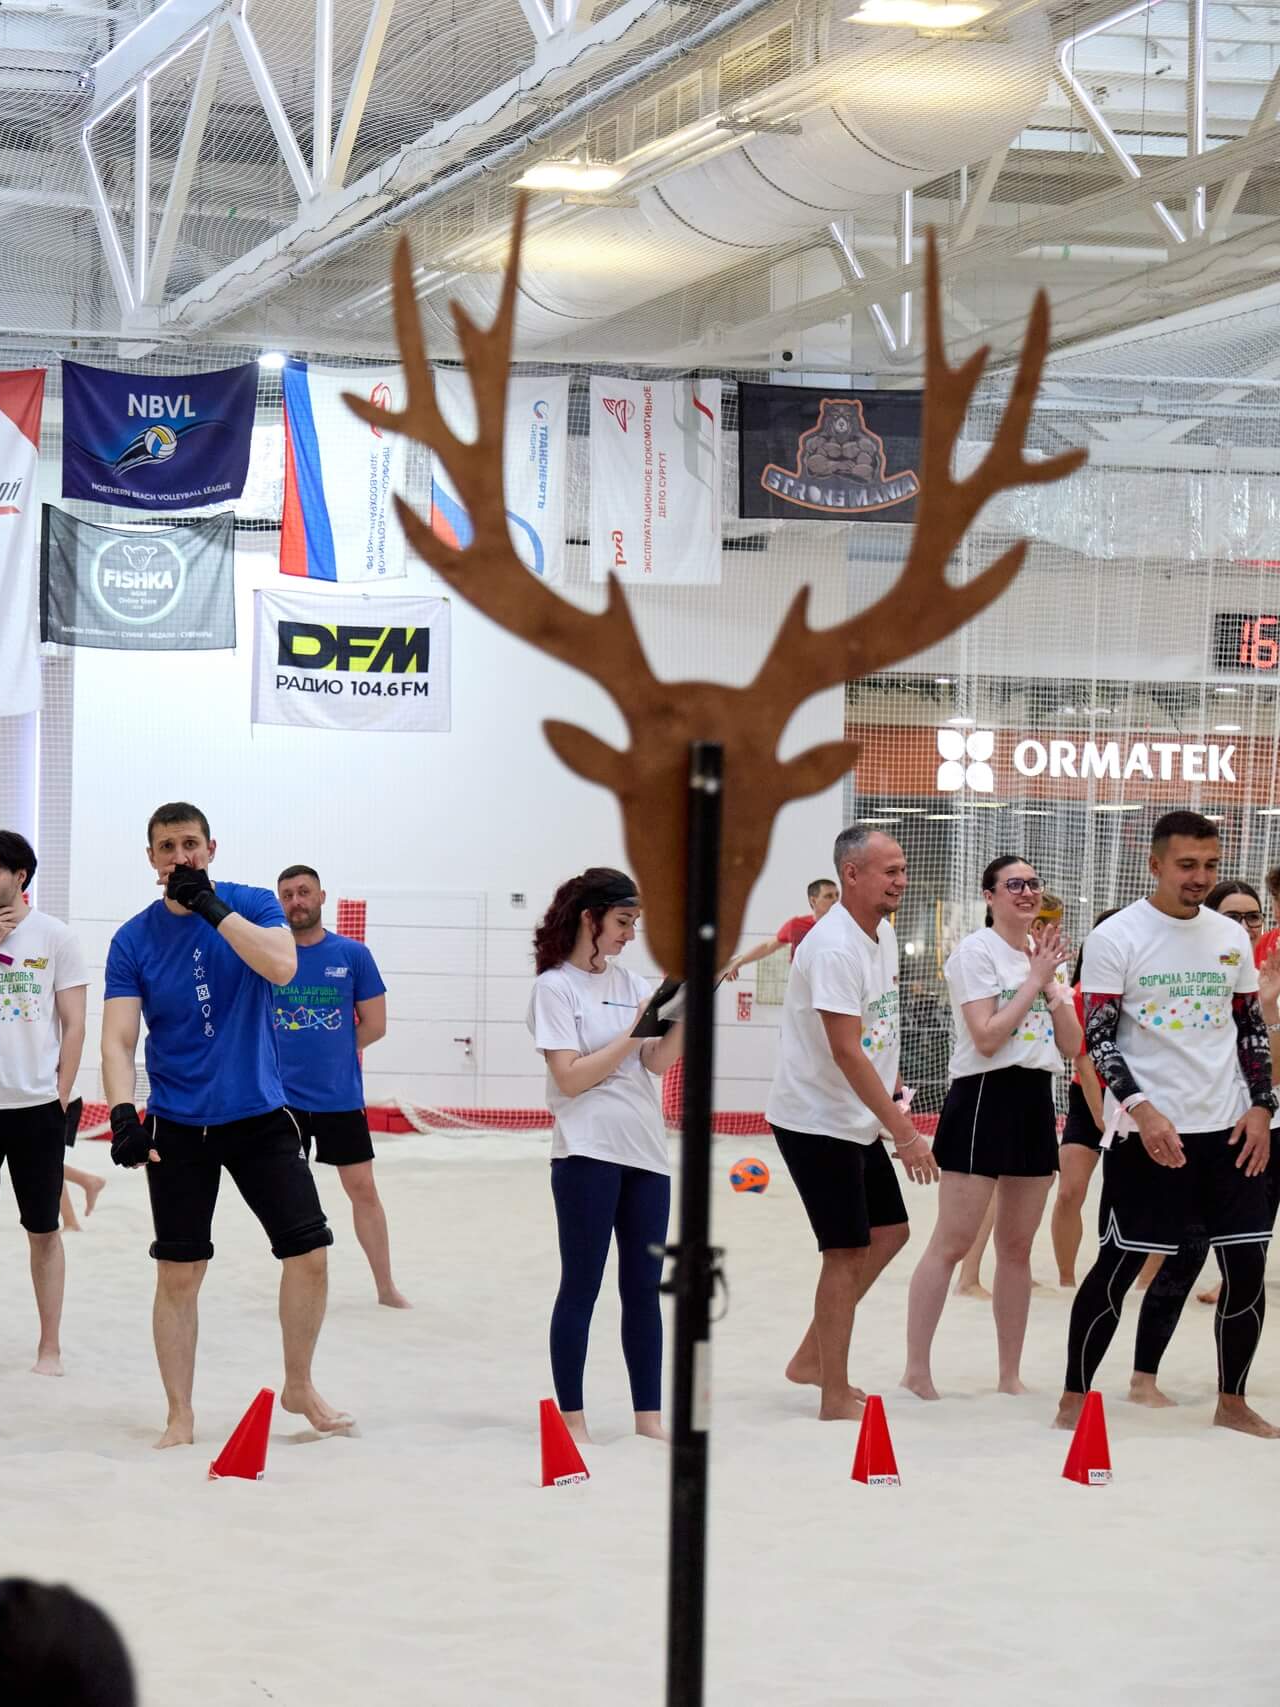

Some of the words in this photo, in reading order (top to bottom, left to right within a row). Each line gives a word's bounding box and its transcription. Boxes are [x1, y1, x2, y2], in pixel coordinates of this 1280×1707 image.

[127, 393, 196, 418] NBVL
[643, 384, 654, 467] ЛОКОМОТИВНОЕ
[537, 425, 549, 510] ТРАНСНЕФТЬ
[658, 451, 667, 487] СУРГУТ
[91, 482, 131, 497] NORTHERN
[131, 490, 157, 501] BEACH
[157, 490, 202, 501] VOLLEYBALL
[203, 482, 232, 495] LEAGUE
[658, 487, 667, 519] ДЕПО
[644, 468, 654, 575] ЭКСПЛУАТАЦИОННОЕ
[103, 568, 174, 590] FISHKA
[277, 620, 431, 674] DFM
[275, 674, 344, 695] РАДИО
[1013, 738, 1238, 784] ORMATEK
[1138, 972, 1183, 987] ФОРМУЛА
[1168, 985, 1195, 998] НАШЕ
